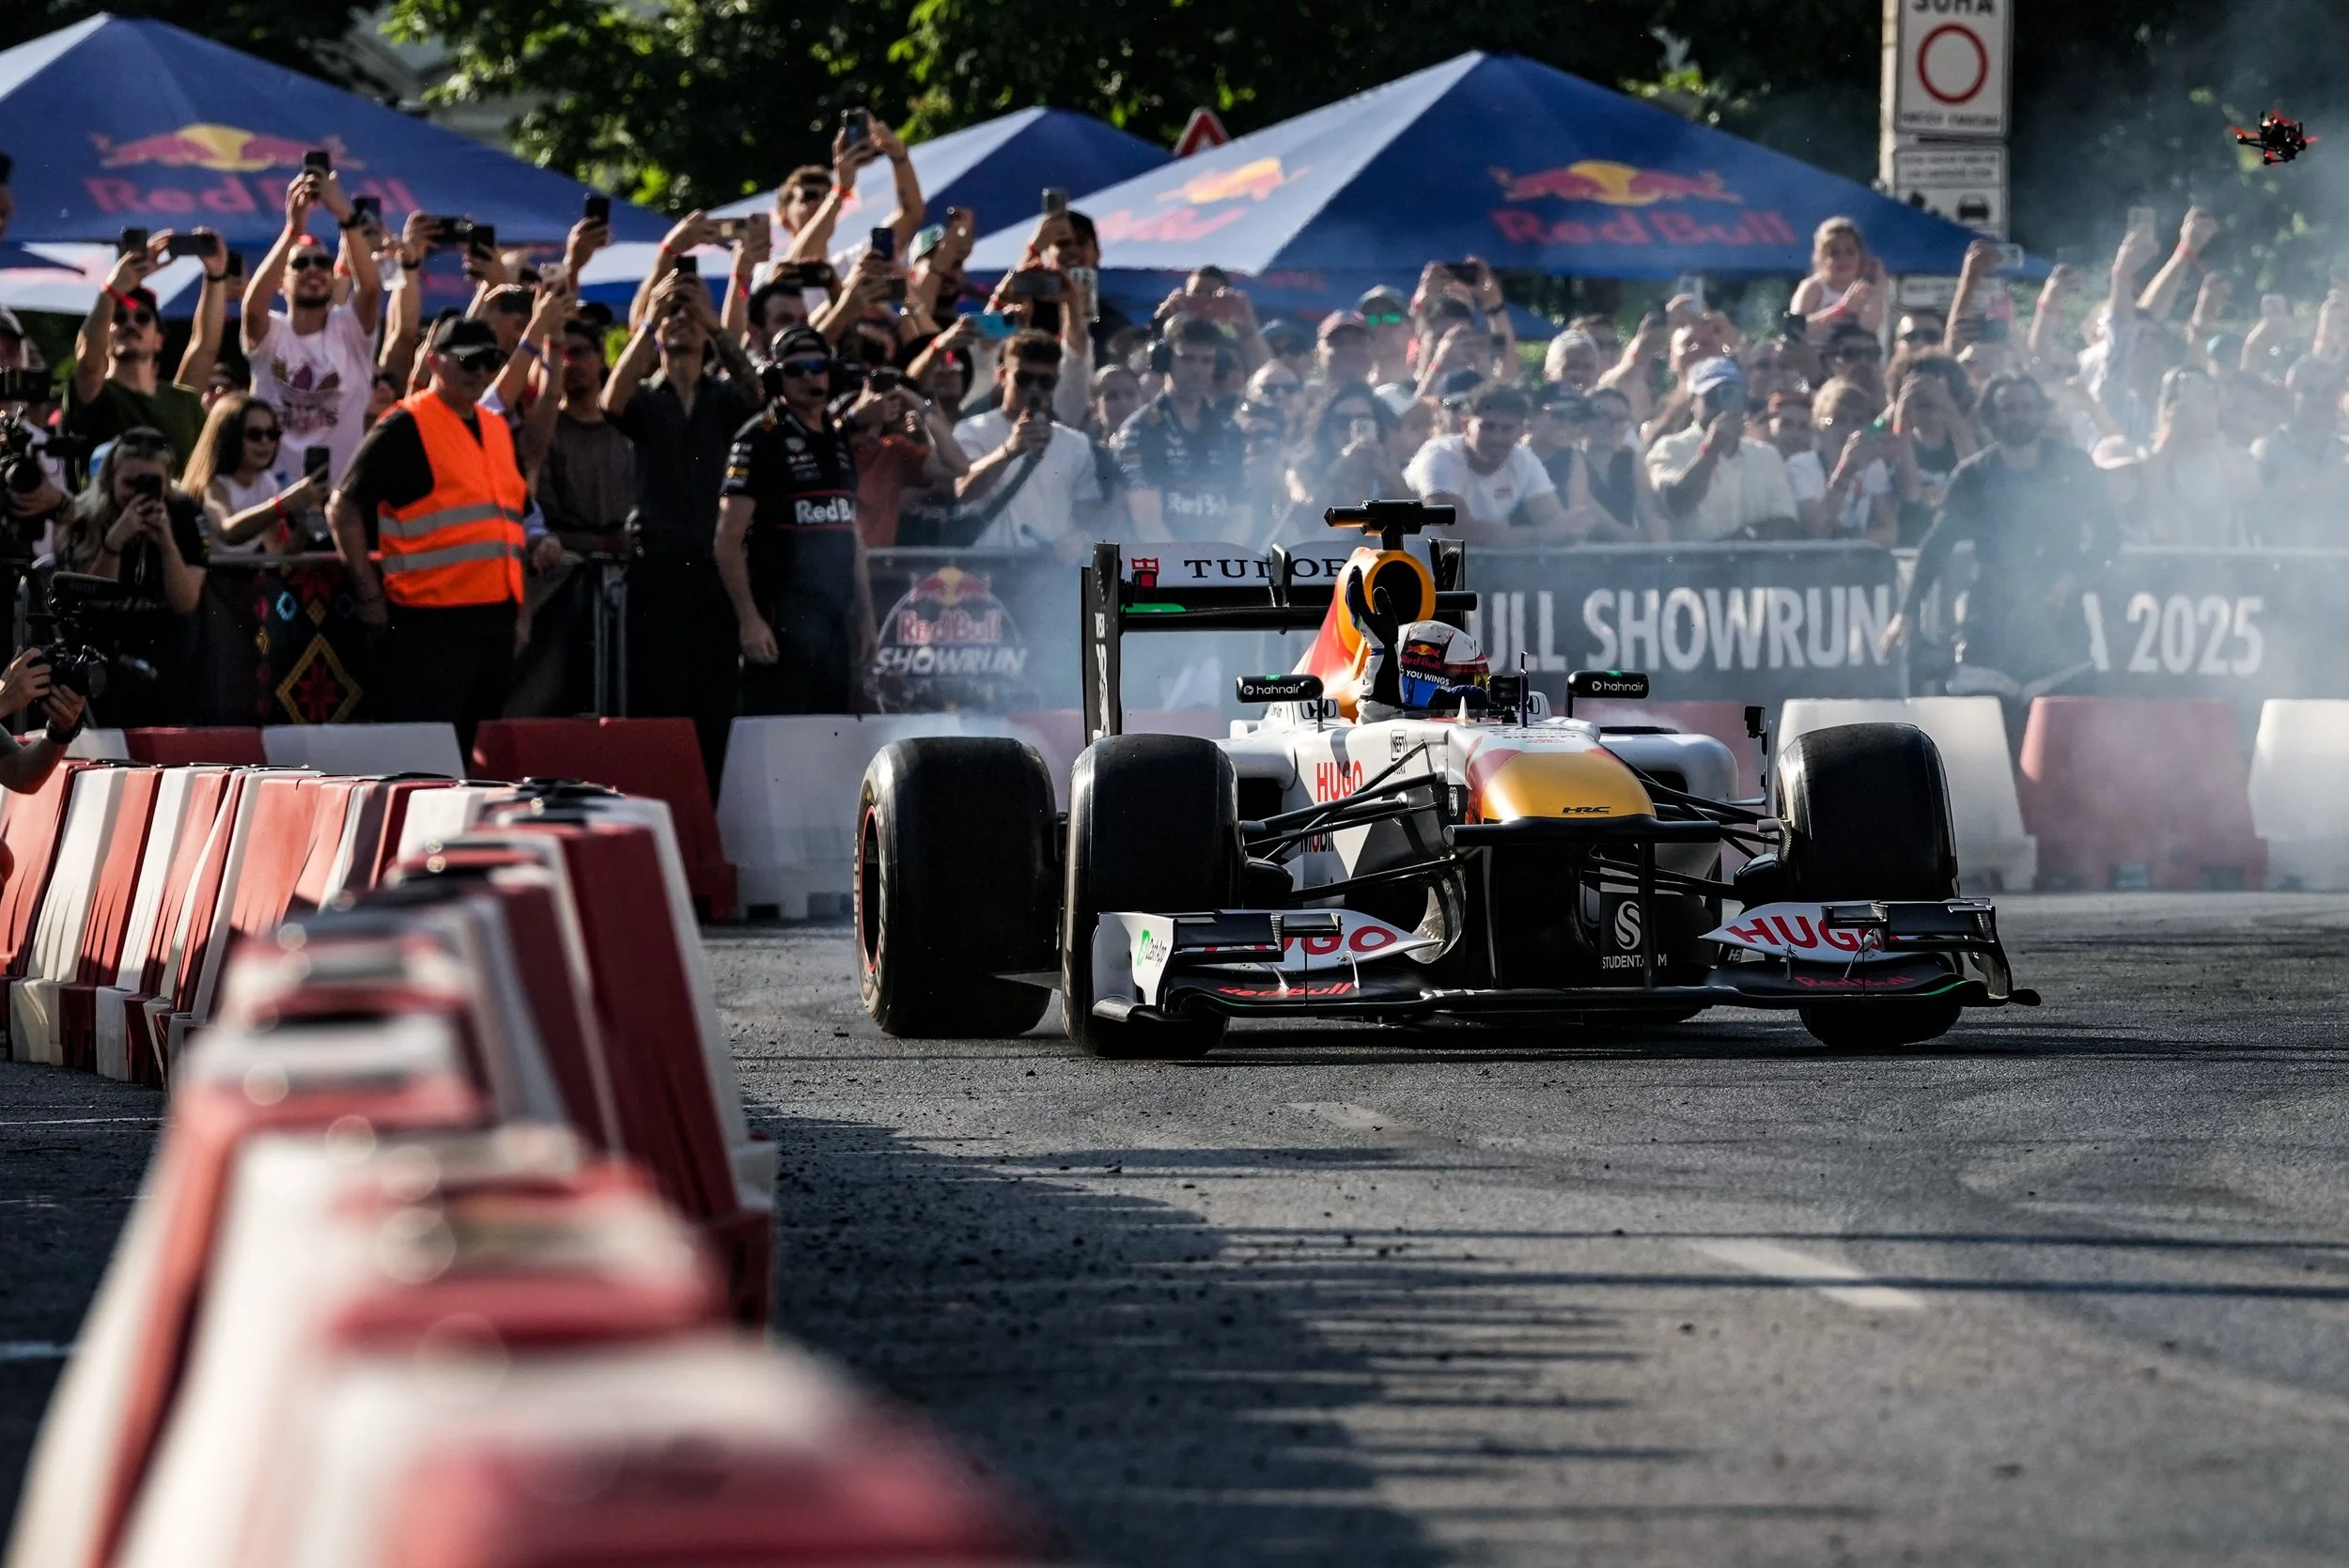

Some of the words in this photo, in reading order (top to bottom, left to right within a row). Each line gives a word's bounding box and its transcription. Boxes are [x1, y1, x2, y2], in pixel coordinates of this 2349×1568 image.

[1489, 209, 1650, 245] Red
[1651, 210, 1798, 245] Bull
[897, 610, 952, 644] Red
[953, 610, 1003, 644] Bull
[1583, 586, 1892, 672] SHOWRUN
[2126, 592, 2264, 676] 2025
[872, 646, 1028, 675] SHOWRUN
[1401, 654, 1420, 665] Red
[1421, 658, 1441, 670] Bull
[1256, 684, 1299, 695] hahnair
[1406, 670, 1423, 679] YOU
[1423, 674, 1450, 686] WINGS
[1603, 681, 1644, 691] hahnair
[1316, 759, 1363, 802] HUGO
[1561, 806, 1611, 815] HRC
